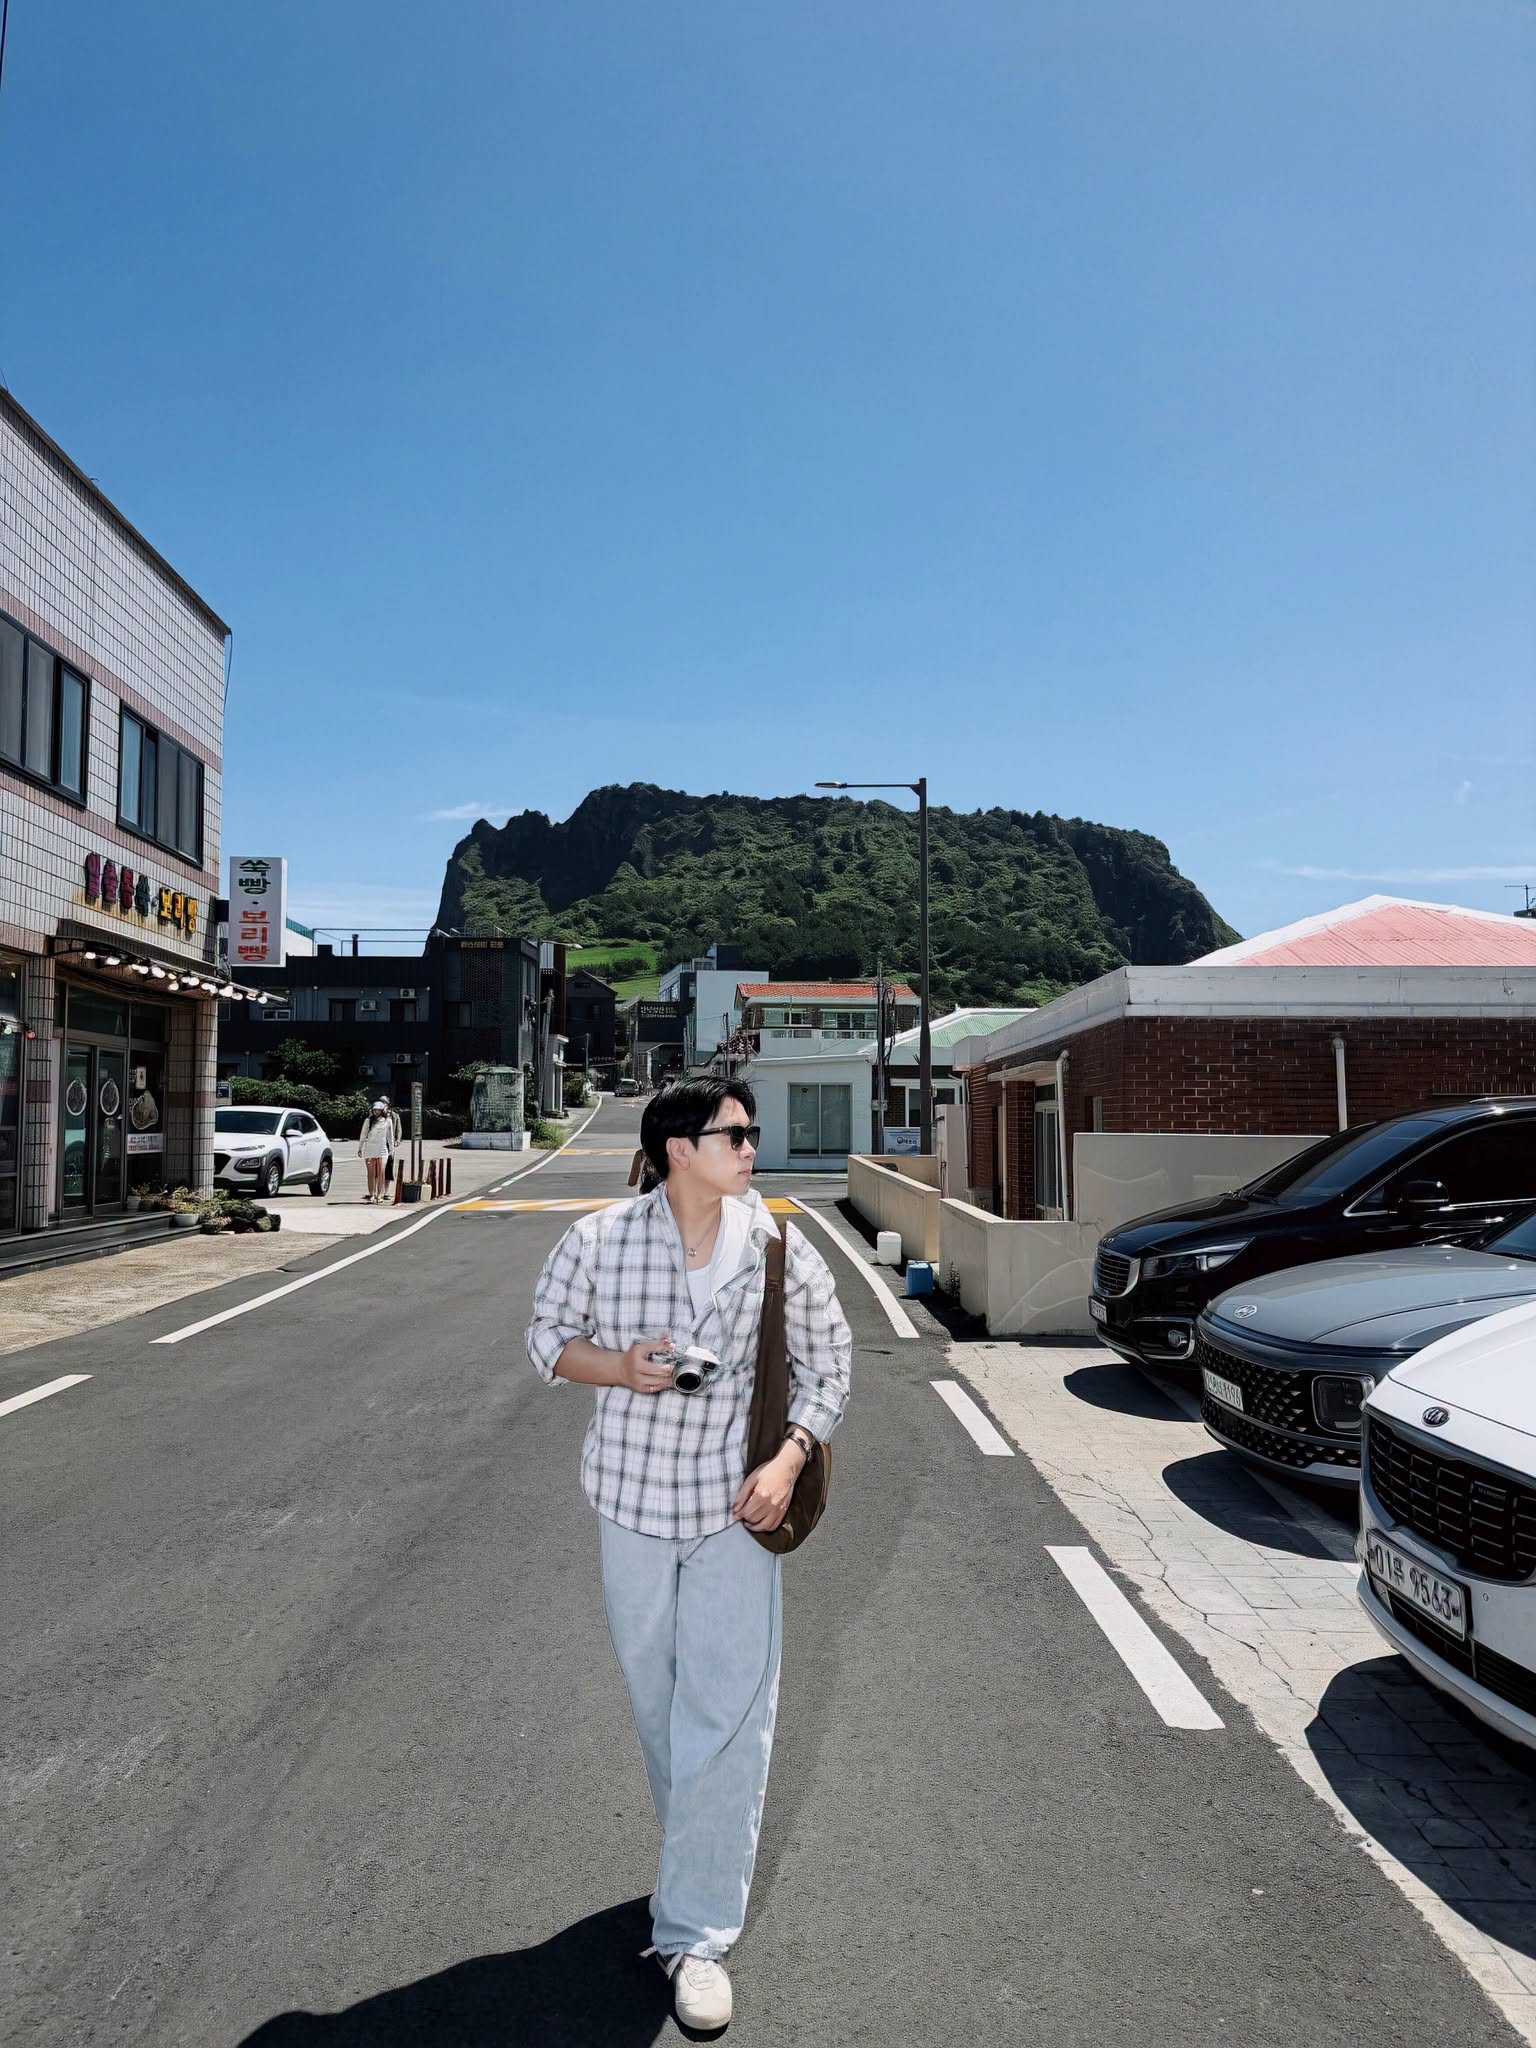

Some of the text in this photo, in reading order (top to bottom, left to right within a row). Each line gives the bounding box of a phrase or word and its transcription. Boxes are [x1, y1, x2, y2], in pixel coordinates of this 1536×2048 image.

[239, 859, 272, 895] 쑥빵
[237, 910, 272, 962] 보리빵
[1409, 1567, 1452, 1621] 9563
